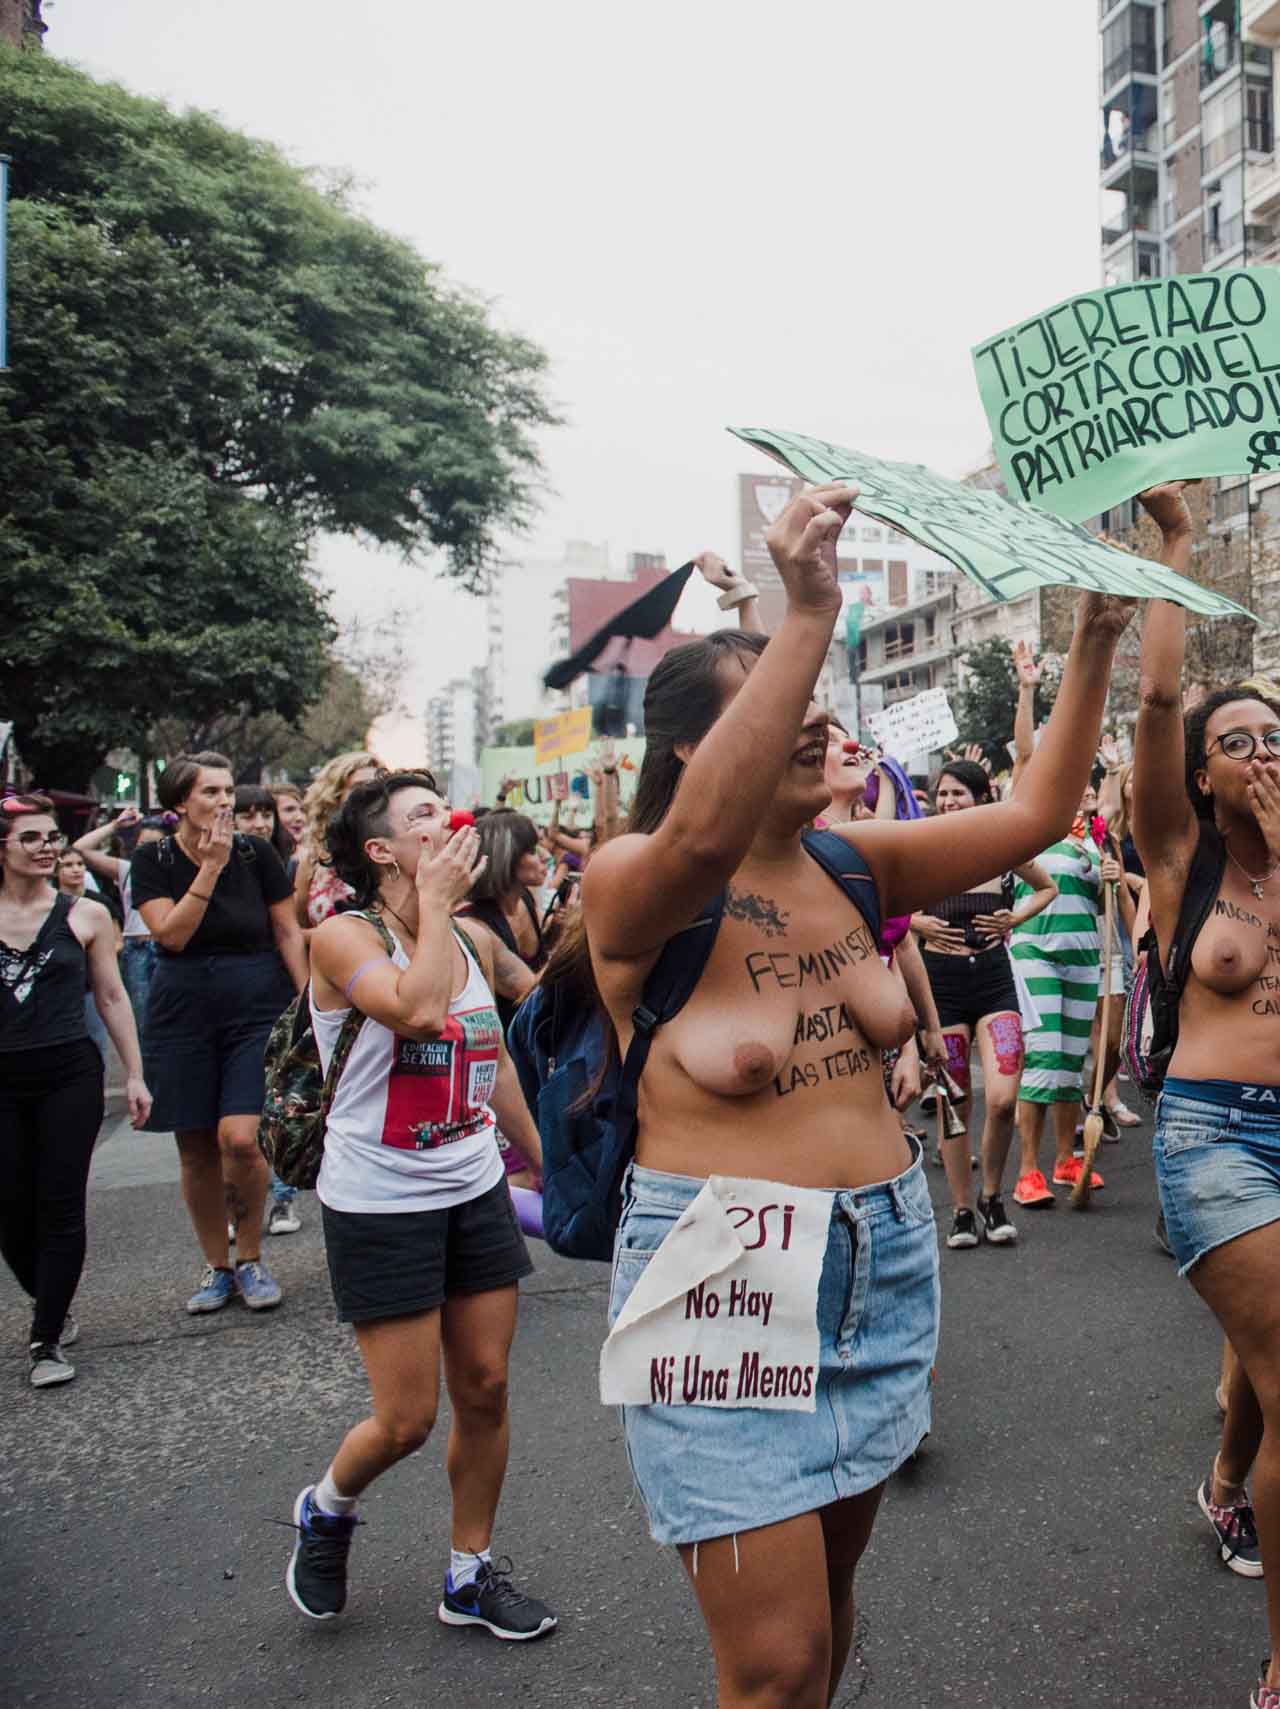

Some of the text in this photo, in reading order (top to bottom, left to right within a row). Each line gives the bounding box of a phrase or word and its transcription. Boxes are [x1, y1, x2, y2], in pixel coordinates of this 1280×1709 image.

[1129, 342, 1213, 390] CON
[793, 1002, 854, 1045] HASTA
[401, 1053, 449, 1065] SEXUAL
[774, 1049, 870, 1096] LAS TETAS
[685, 1279, 773, 1325] No Hay
[650, 1352, 814, 1404] Ni Una Menos
